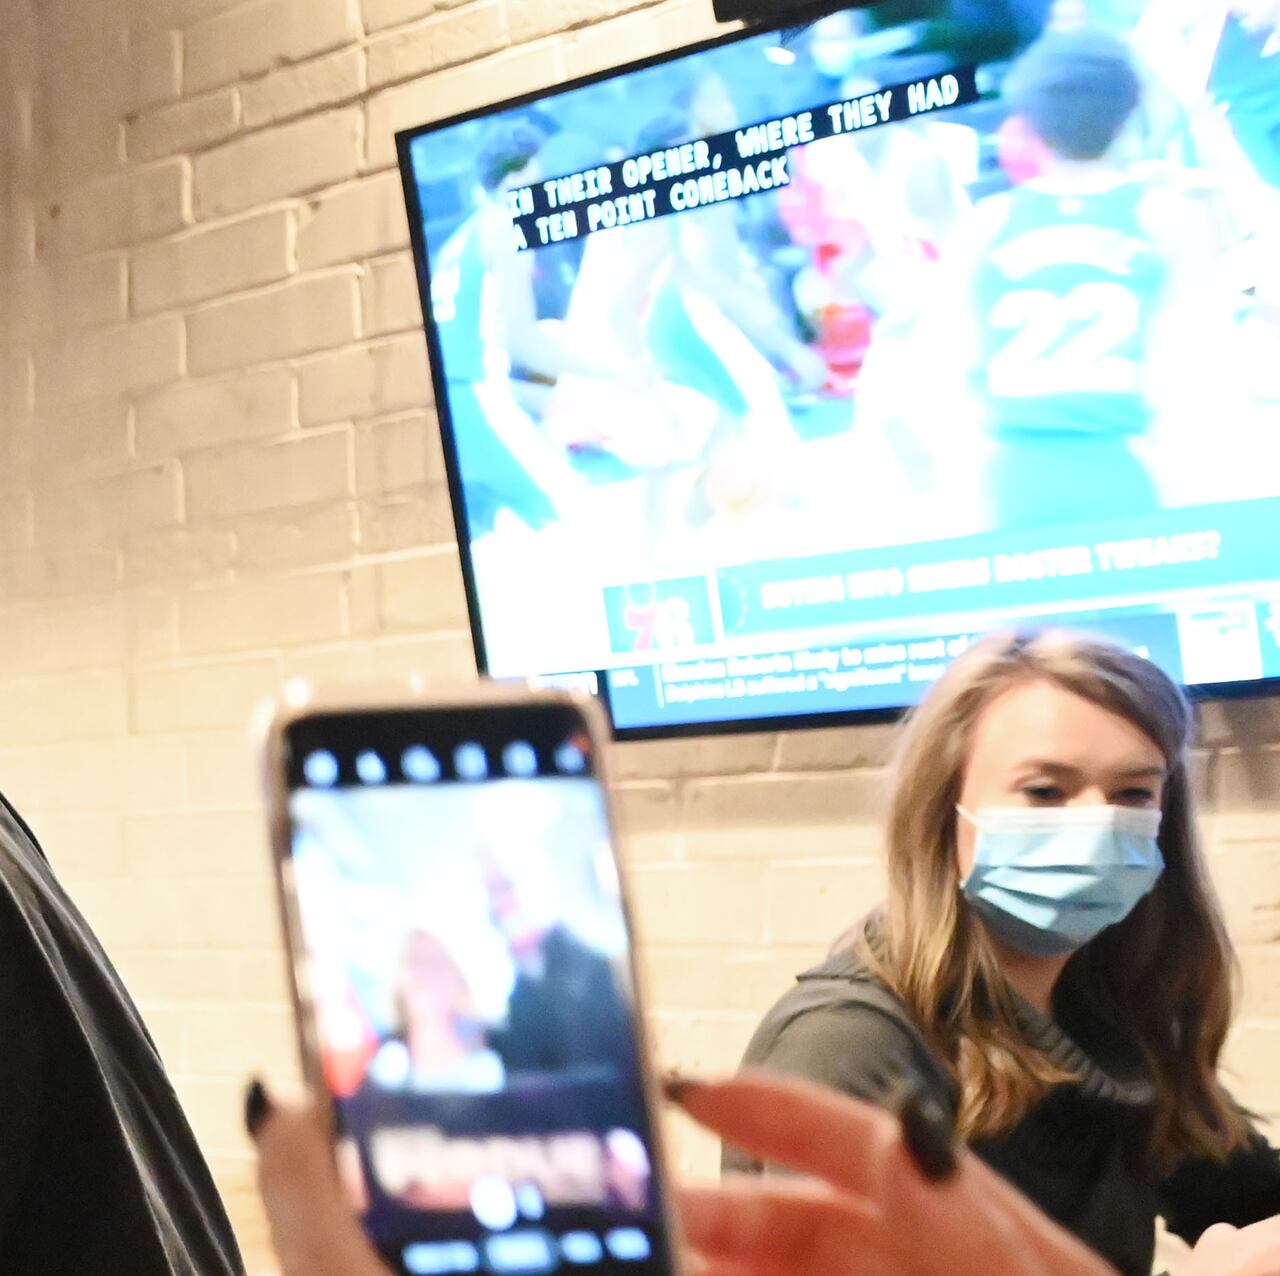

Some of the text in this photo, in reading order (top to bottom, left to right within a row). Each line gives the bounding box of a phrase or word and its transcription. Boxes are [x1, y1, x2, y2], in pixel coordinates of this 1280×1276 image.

[509, 75, 960, 217] IN THEIR OPENER, WHERE THEY HAD
[536, 210, 579, 245] TEN
[588, 190, 657, 237] POINT
[670, 157, 790, 210] COMEBACK
[989, 281, 1140, 397] 22
